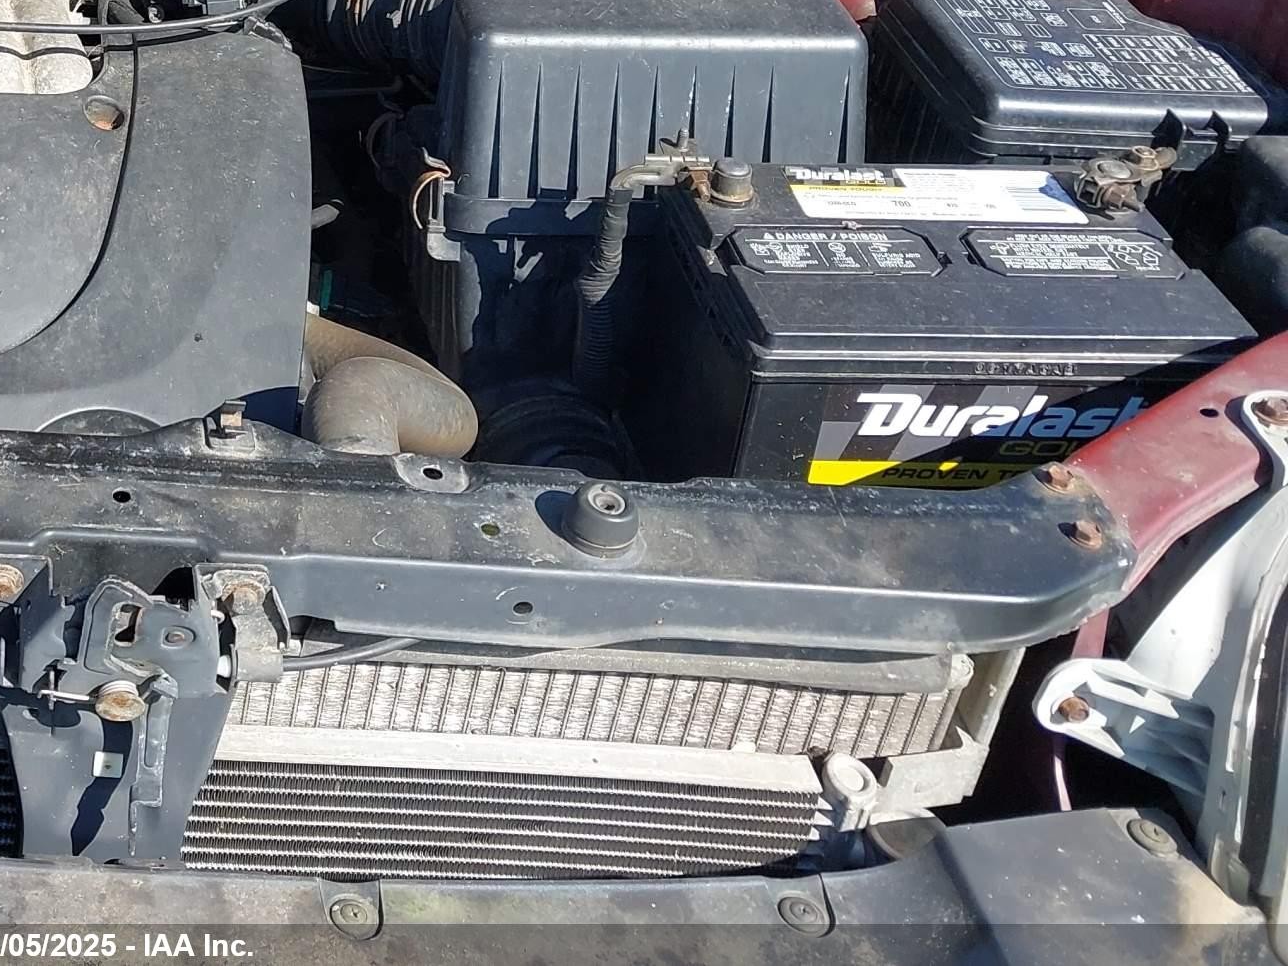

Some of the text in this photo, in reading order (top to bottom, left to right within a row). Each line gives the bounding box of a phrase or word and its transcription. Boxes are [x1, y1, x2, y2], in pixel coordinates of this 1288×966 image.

[790, 168, 885, 181] Duralast
[893, 200, 912, 208] 700
[775, 232, 828, 240] DANGER
[839, 233, 889, 241] POISON
[881, 467, 988, 480] PROVEN
